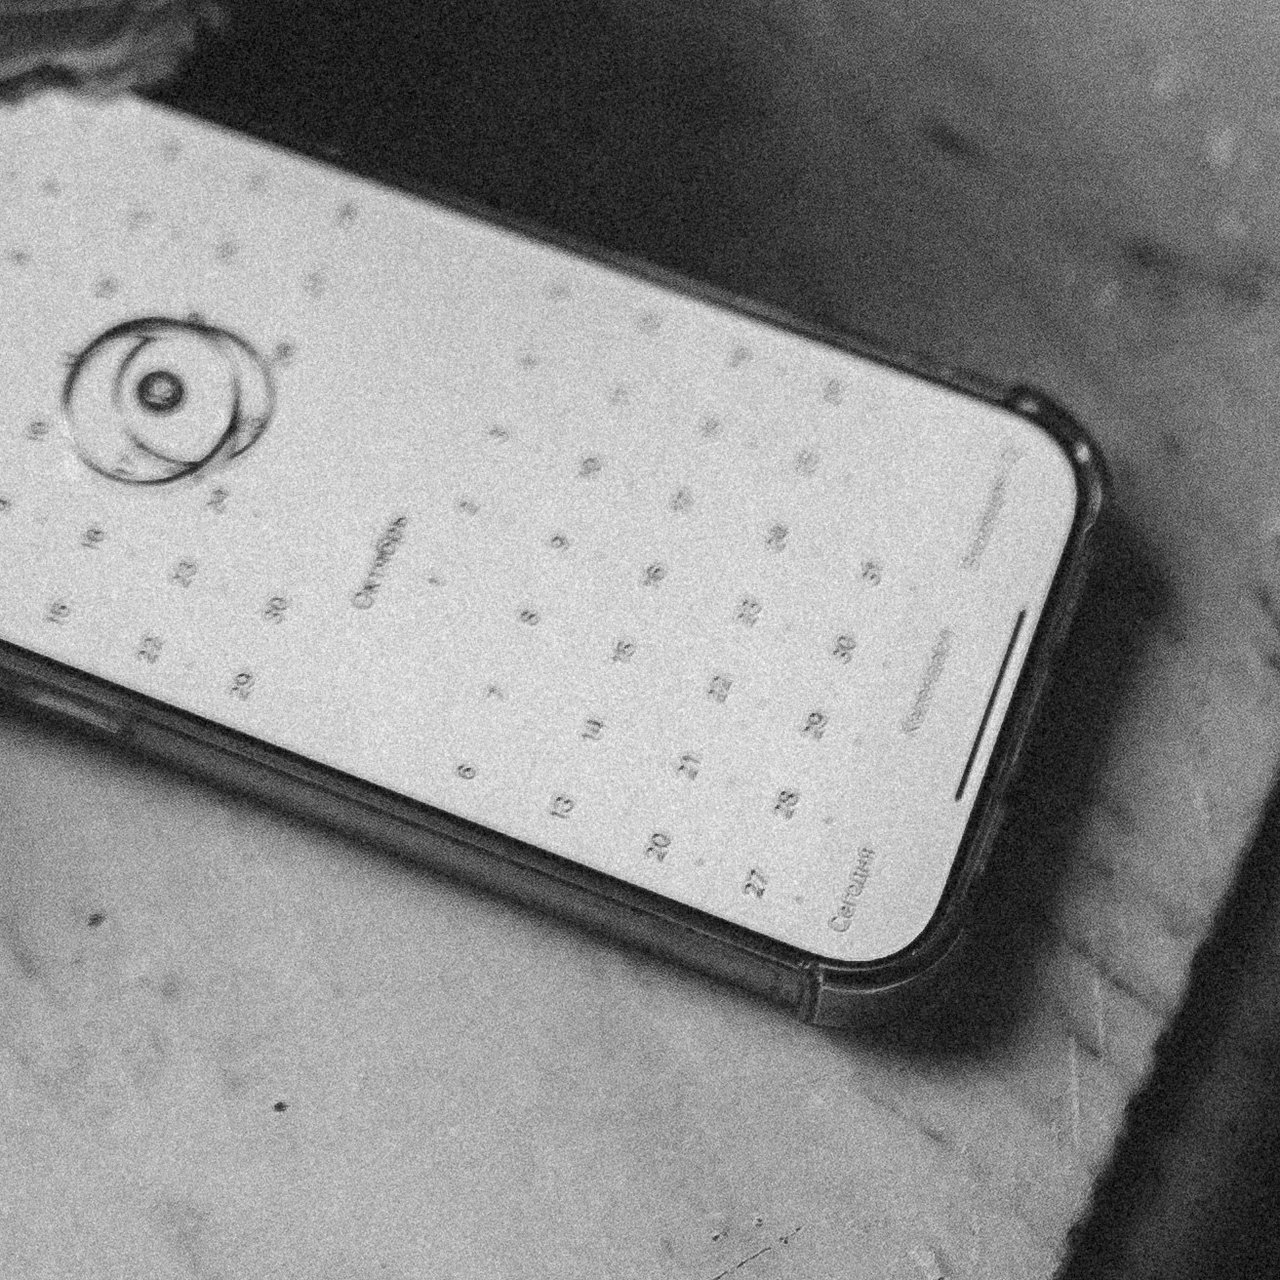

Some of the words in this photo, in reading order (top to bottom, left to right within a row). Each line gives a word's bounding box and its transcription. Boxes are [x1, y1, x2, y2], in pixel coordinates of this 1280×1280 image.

[135, 634, 164, 664] 22
[170, 559, 197, 588] 23
[353, 516, 407, 609] Октябрь
[230, 671, 253, 700] 29
[263, 595, 288, 624] 30
[456, 764, 476, 780] 6
[519, 609, 539, 625] 8
[550, 534, 570, 550] 9
[549, 794, 574, 819] 13
[581, 718, 605, 740] 14
[611, 640, 636, 662] 15
[644, 832, 671, 862] 20
[676, 753, 699, 780] 21
[706, 674, 732, 703] 22
[737, 597, 762, 627] 23
[743, 868, 767, 899] 27
[773, 790, 799, 819] 28
[802, 710, 827, 740] 29
[831, 634, 857, 664] 30
[861, 560, 882, 585] 31
[828, 846, 875, 933] Сегодня
